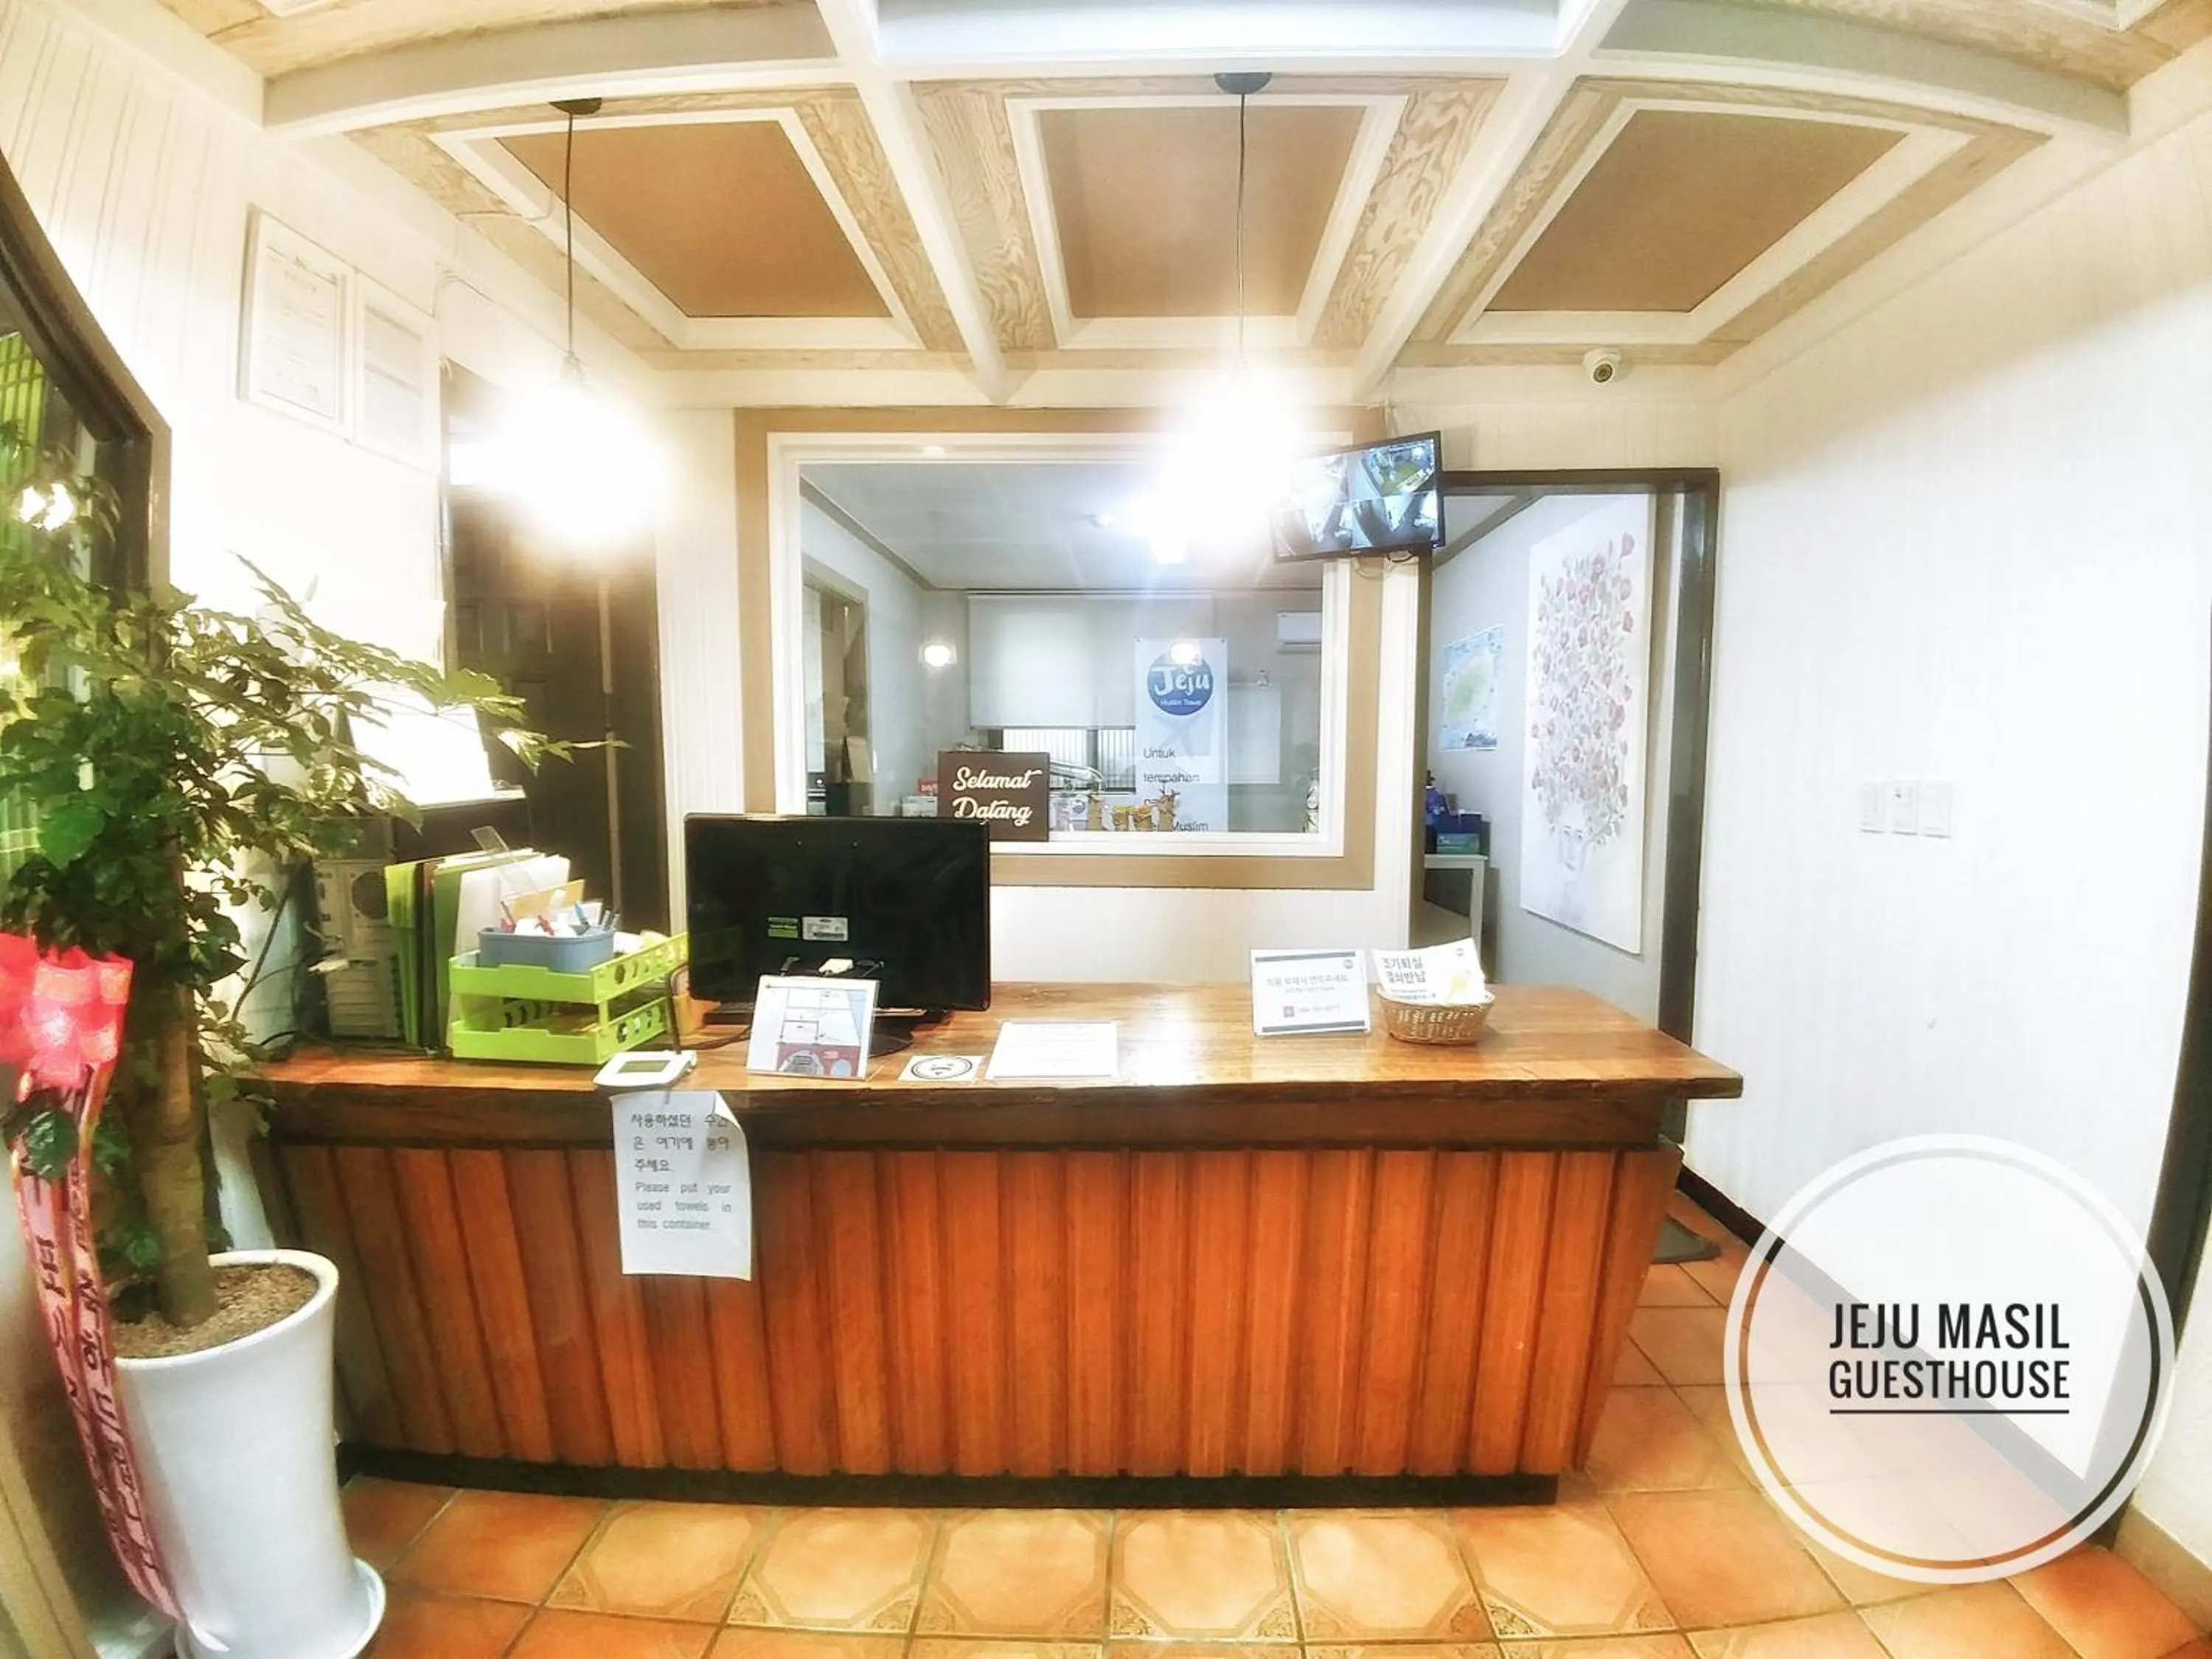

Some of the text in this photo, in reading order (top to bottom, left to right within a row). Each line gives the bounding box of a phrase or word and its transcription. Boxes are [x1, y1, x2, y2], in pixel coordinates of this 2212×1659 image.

[1152, 665, 1209, 696] Jeju
[1143, 748, 1176, 759] Untuk
[953, 766, 1043, 791] Selamat
[953, 796, 1032, 827] Datang
[632, 1114, 691, 1128] 사용하셨던
[634, 1136, 644, 1150] 은
[656, 1137, 693, 1150] 여기에
[636, 1182, 731, 1194] Please put your
[636, 1202, 731, 1212] used towels in
[637, 1219, 658, 1229] this
